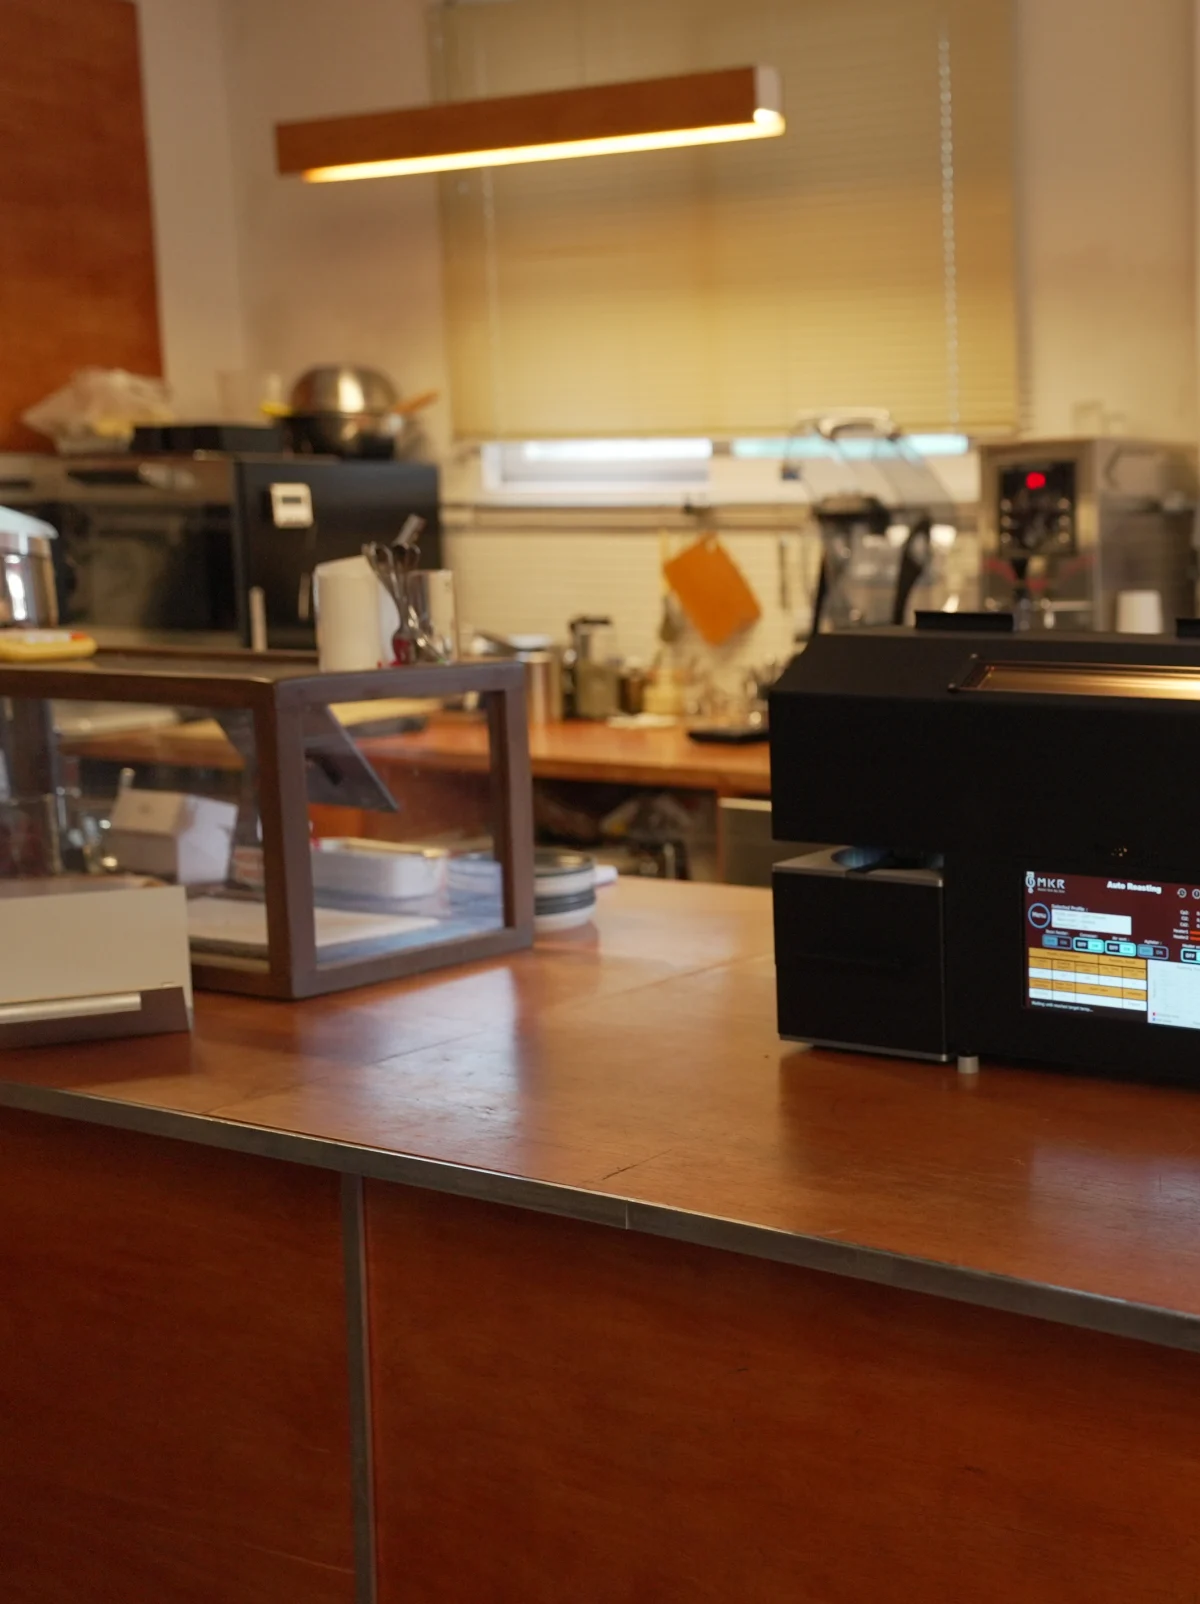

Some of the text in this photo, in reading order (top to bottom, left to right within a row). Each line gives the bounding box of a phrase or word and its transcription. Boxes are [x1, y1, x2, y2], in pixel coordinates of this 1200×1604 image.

[1037, 877, 1065, 889] MKR
[1106, 881, 1162, 894] Auto Roasting
